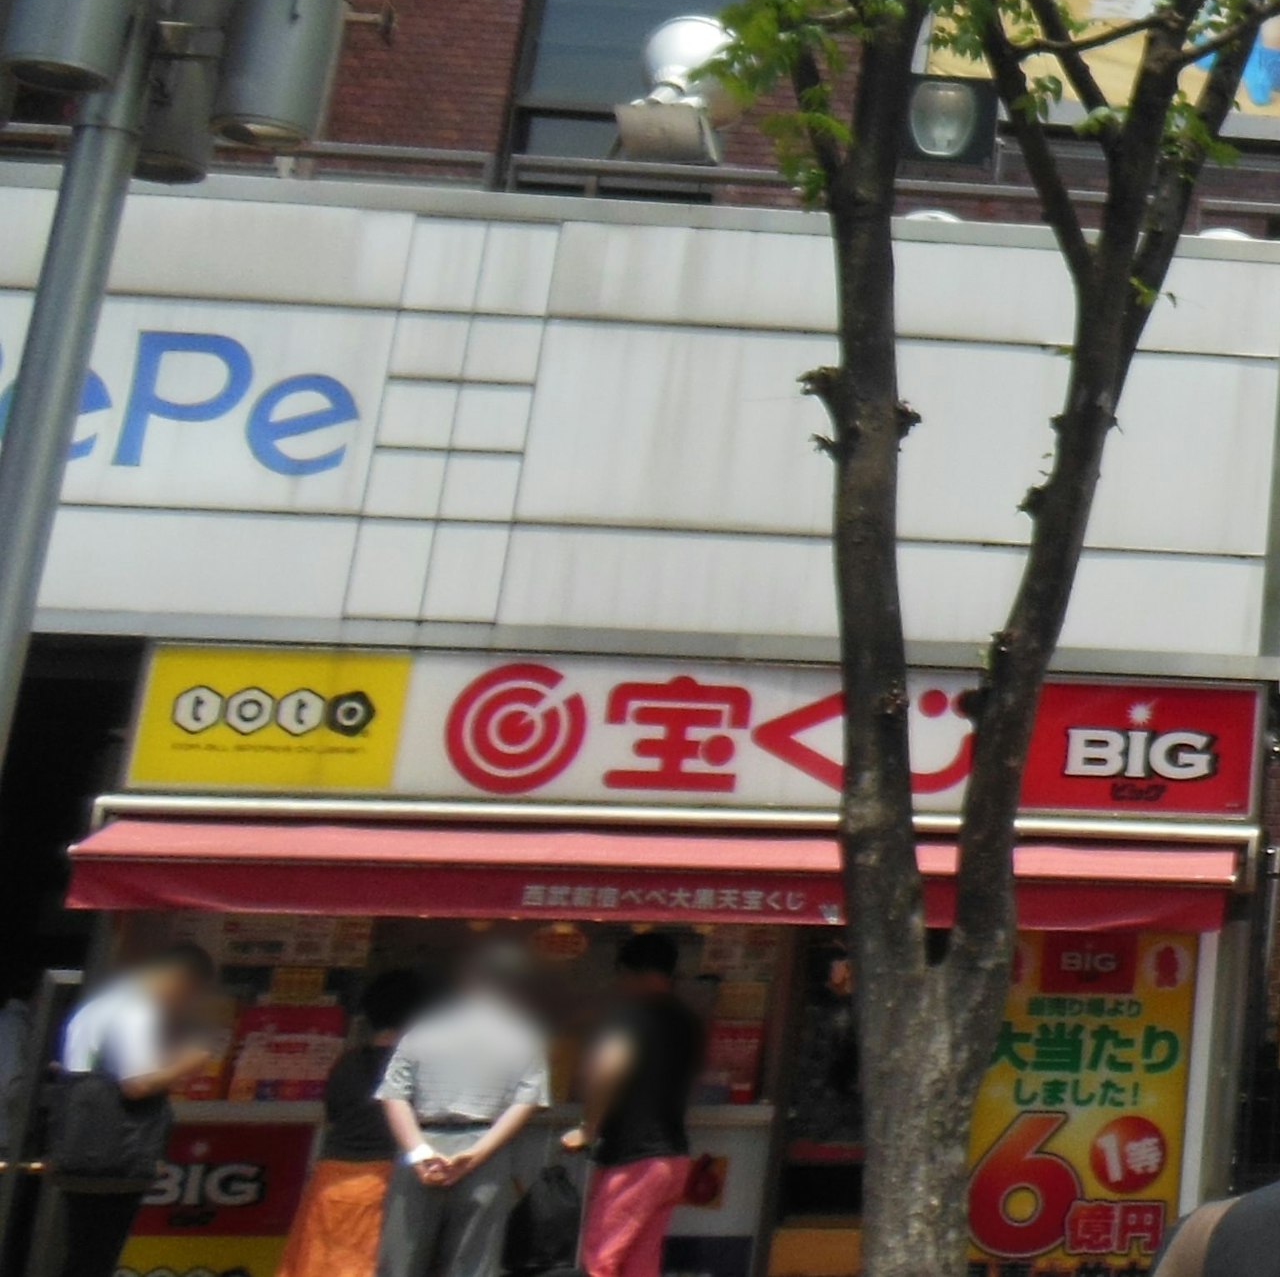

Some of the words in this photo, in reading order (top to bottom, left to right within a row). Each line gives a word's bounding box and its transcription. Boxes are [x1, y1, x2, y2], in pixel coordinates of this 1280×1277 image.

[181, 689, 371, 733] toto
[1063, 727, 1214, 781] BIG
[1060, 951, 1117, 972] BIG
[990, 1021, 1180, 1074] 大当たり
